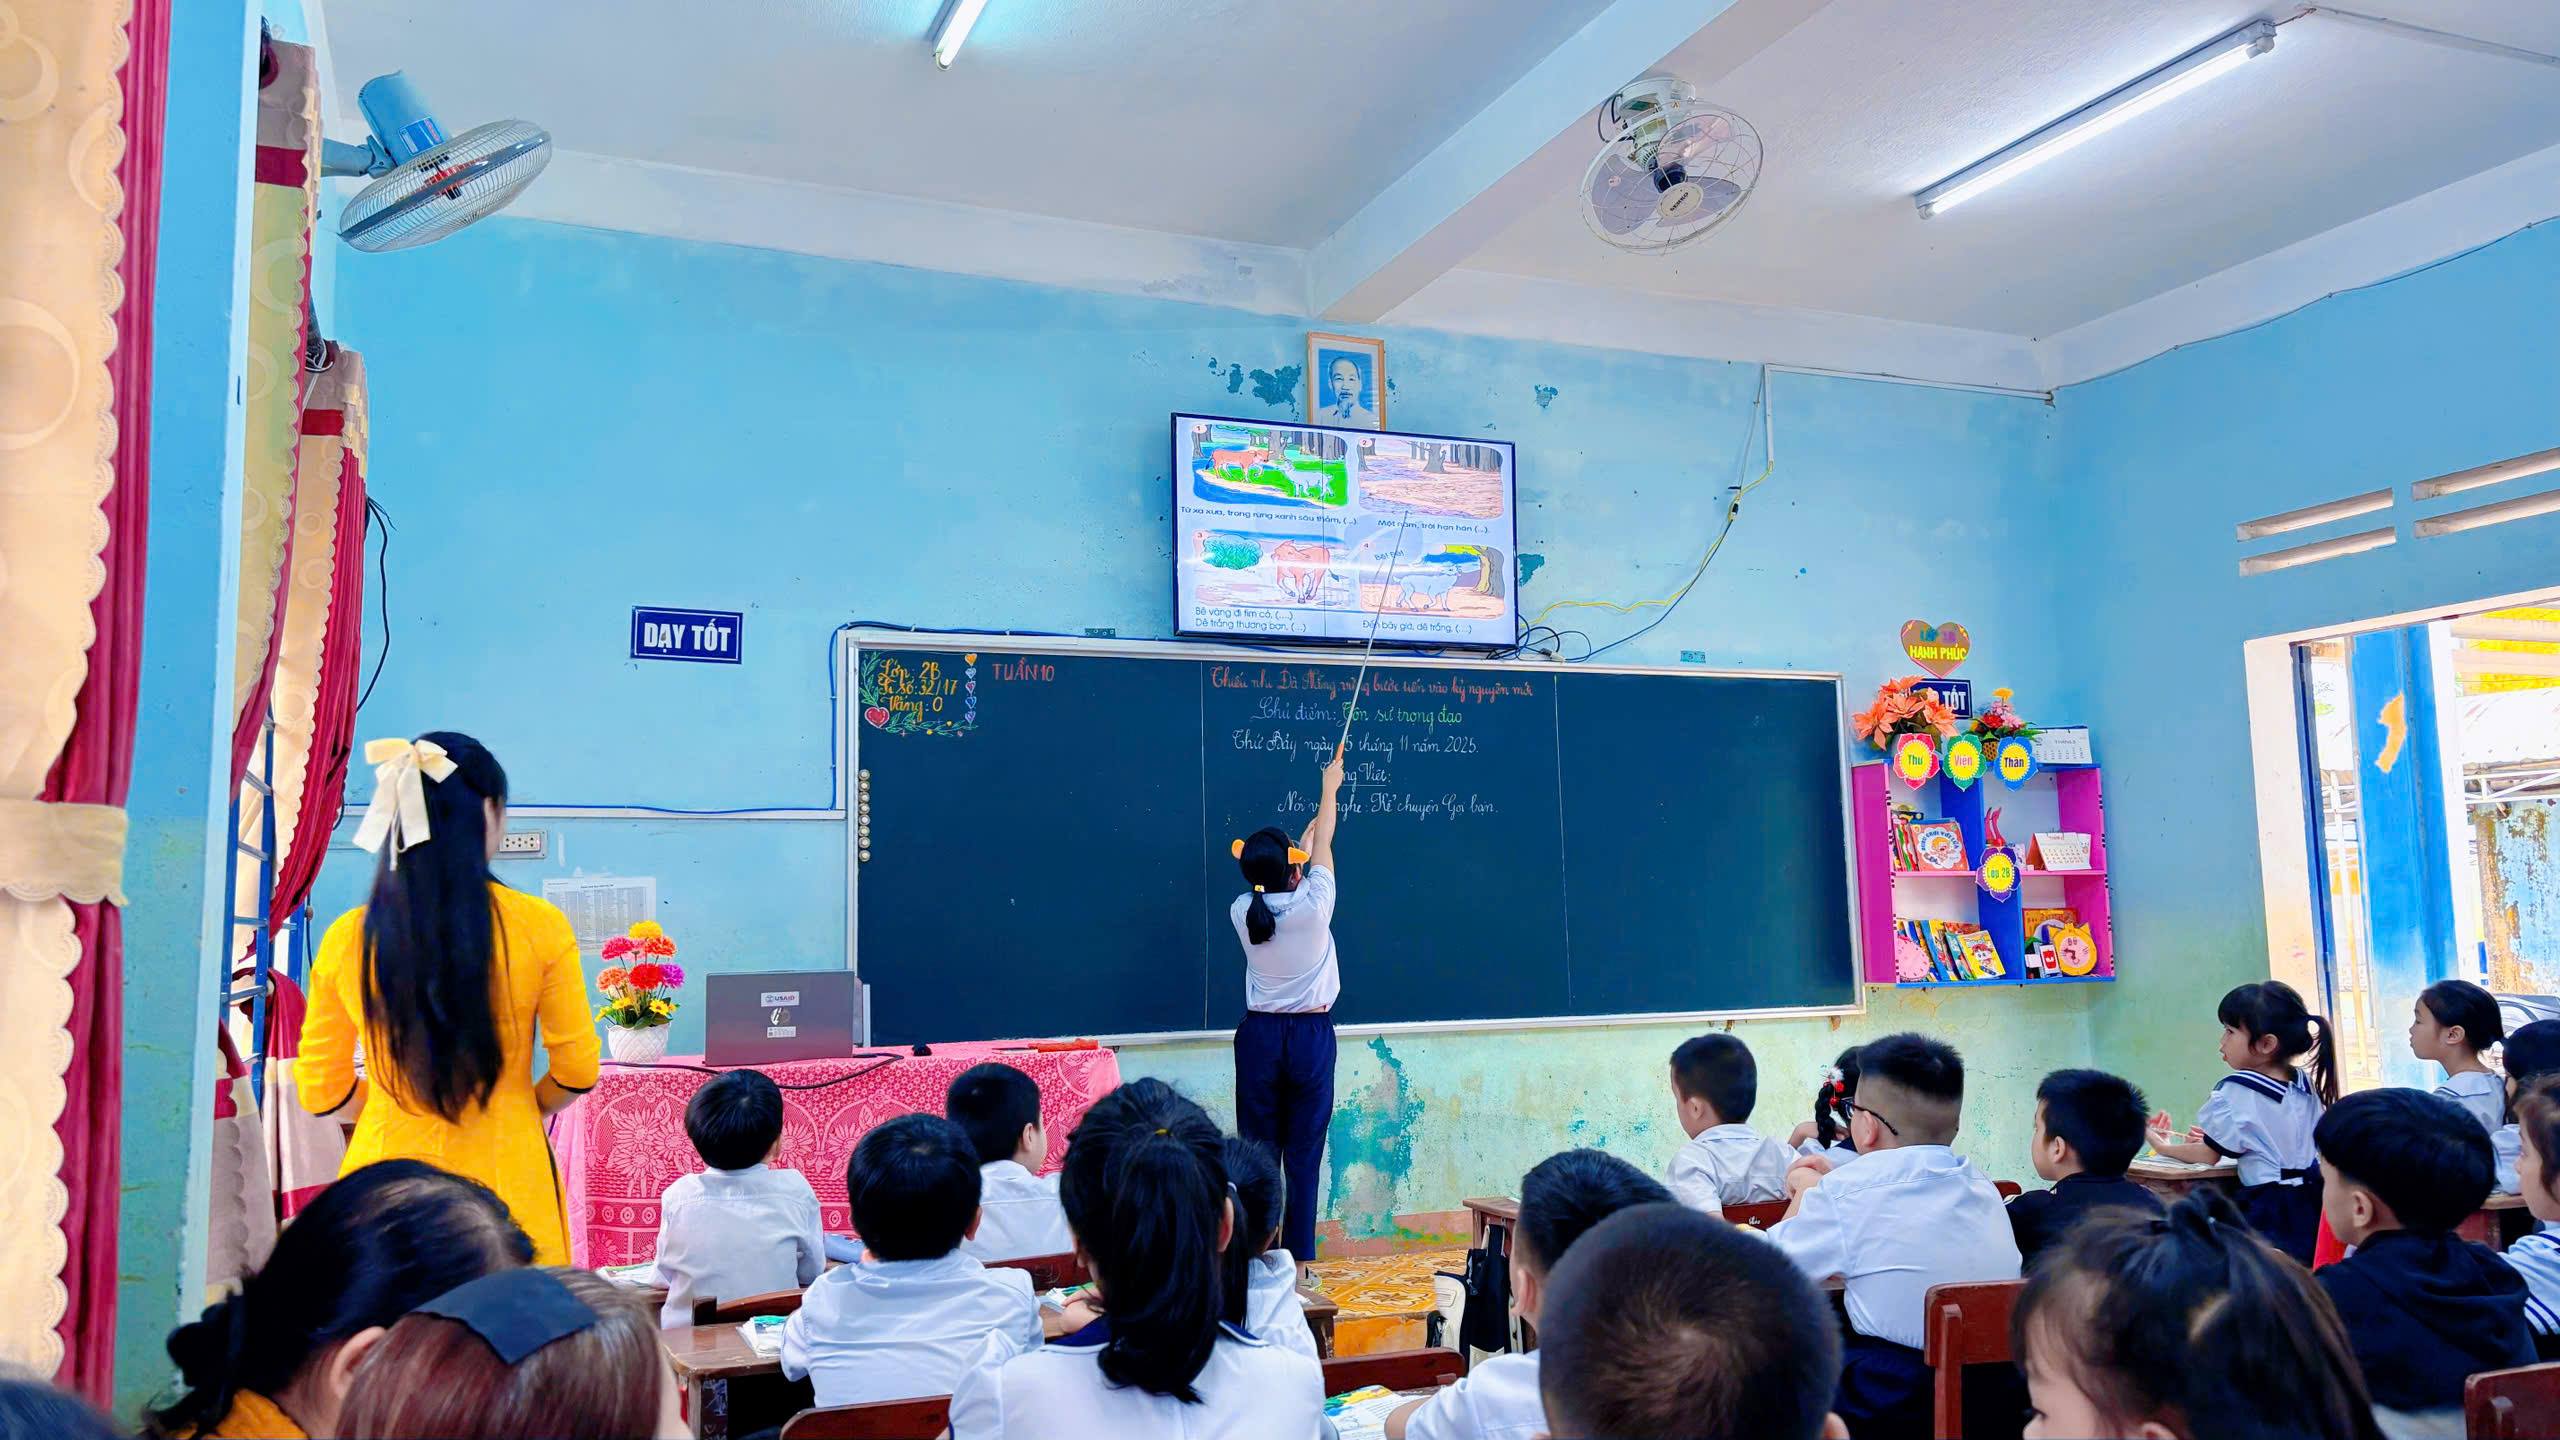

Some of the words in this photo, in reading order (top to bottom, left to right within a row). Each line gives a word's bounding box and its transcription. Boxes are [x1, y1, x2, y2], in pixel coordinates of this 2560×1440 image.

[1227, 509, 1251, 519] trong
[1274, 512, 1297, 521] xanh
[643, 622, 686, 653] DẠY
[691, 618, 732, 652] TỐT
[1940, 643, 1967, 660] PHÚC
[919, 661, 941, 680] 2B
[1040, 664, 1055, 682] 10
[1276, 668, 1298, 690] Đà
[1428, 681, 1448, 694] vào
[932, 696, 943, 712] 0
[1942, 685, 1967, 710] TỐT
[1295, 702, 1337, 721] điểm:
[1397, 706, 1434, 734] trọng
[1438, 704, 1463, 726] đạo
[1232, 729, 1265, 750] Thứ
[1304, 735, 1334, 763] ngày
[1359, 732, 1394, 763] tháng
[1400, 734, 1409, 752] 11
[1412, 738, 1441, 752] năm
[1277, 791, 1306, 812] Nói
[774, 994, 796, 1002] USAID
